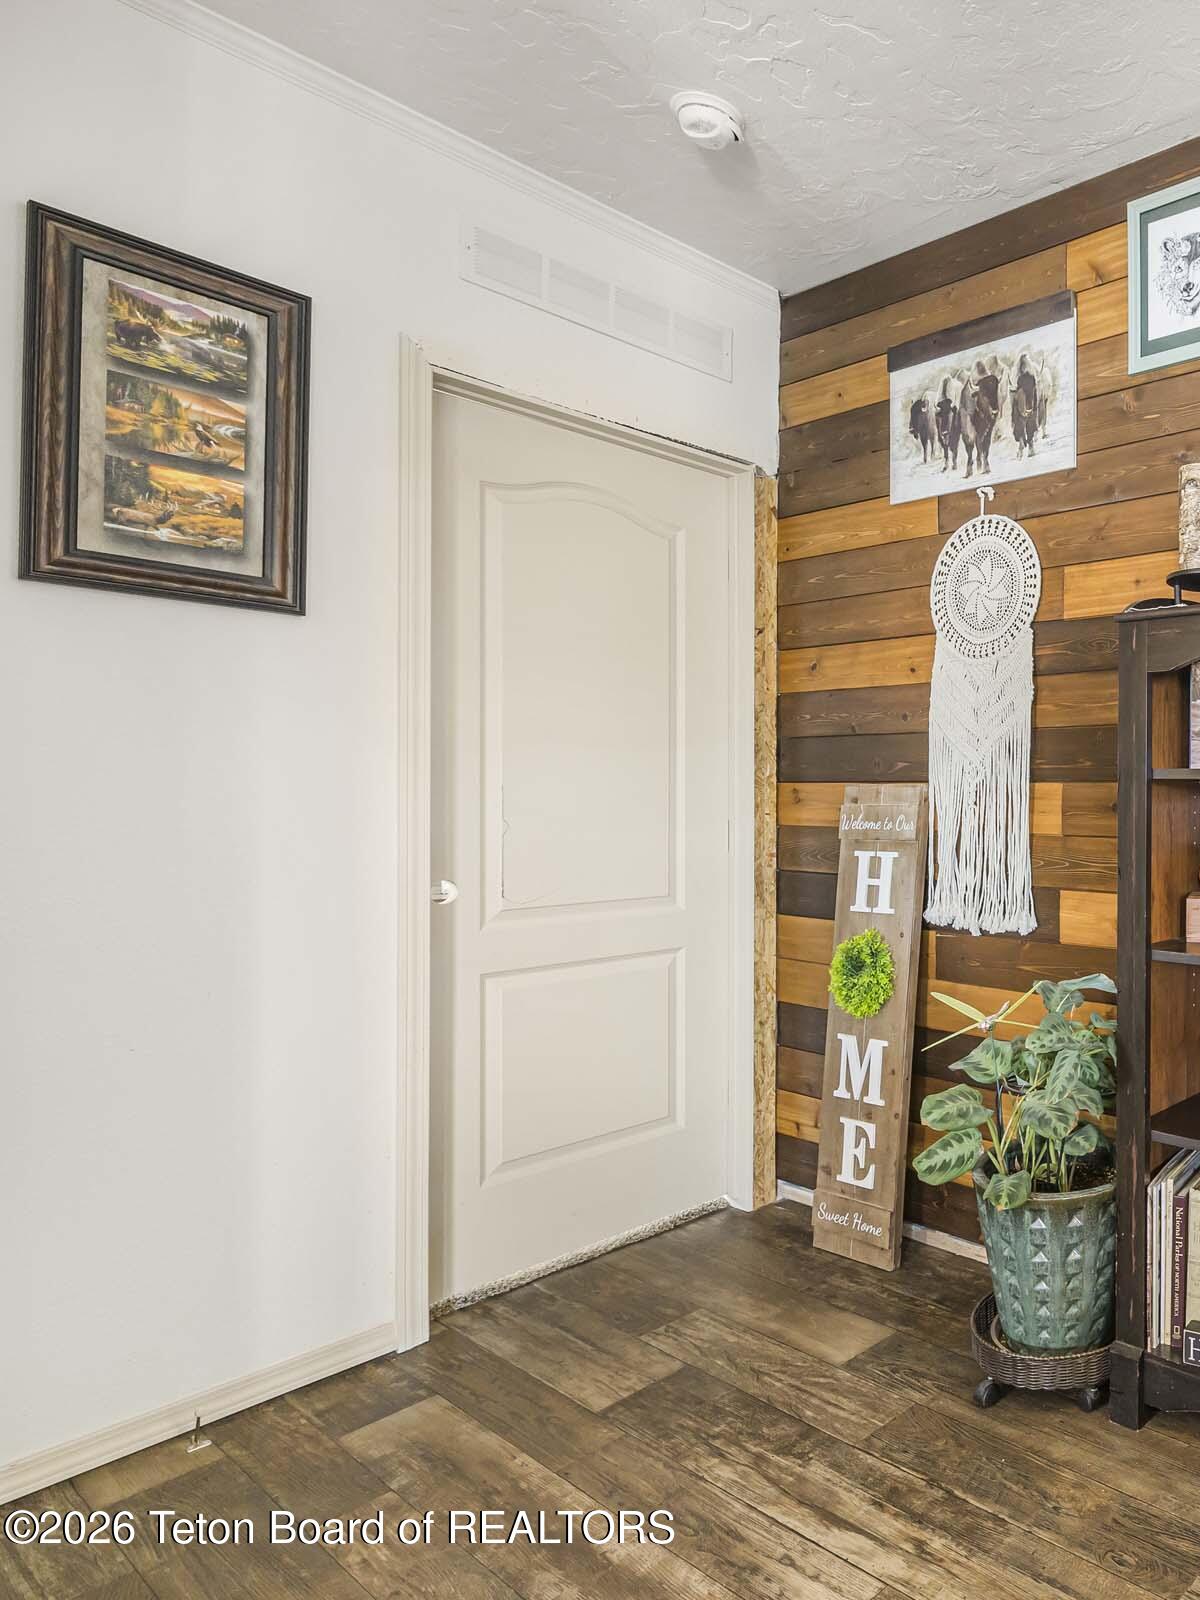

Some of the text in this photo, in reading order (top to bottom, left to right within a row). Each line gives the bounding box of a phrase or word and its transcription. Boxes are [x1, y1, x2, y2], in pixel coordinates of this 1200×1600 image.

[841, 814, 915, 832] Welcome to Our
[817, 1202, 882, 1238] Sweet Home
[1175, 1207, 1184, 1240] National
[1174, 1240, 1183, 1262] Parks
